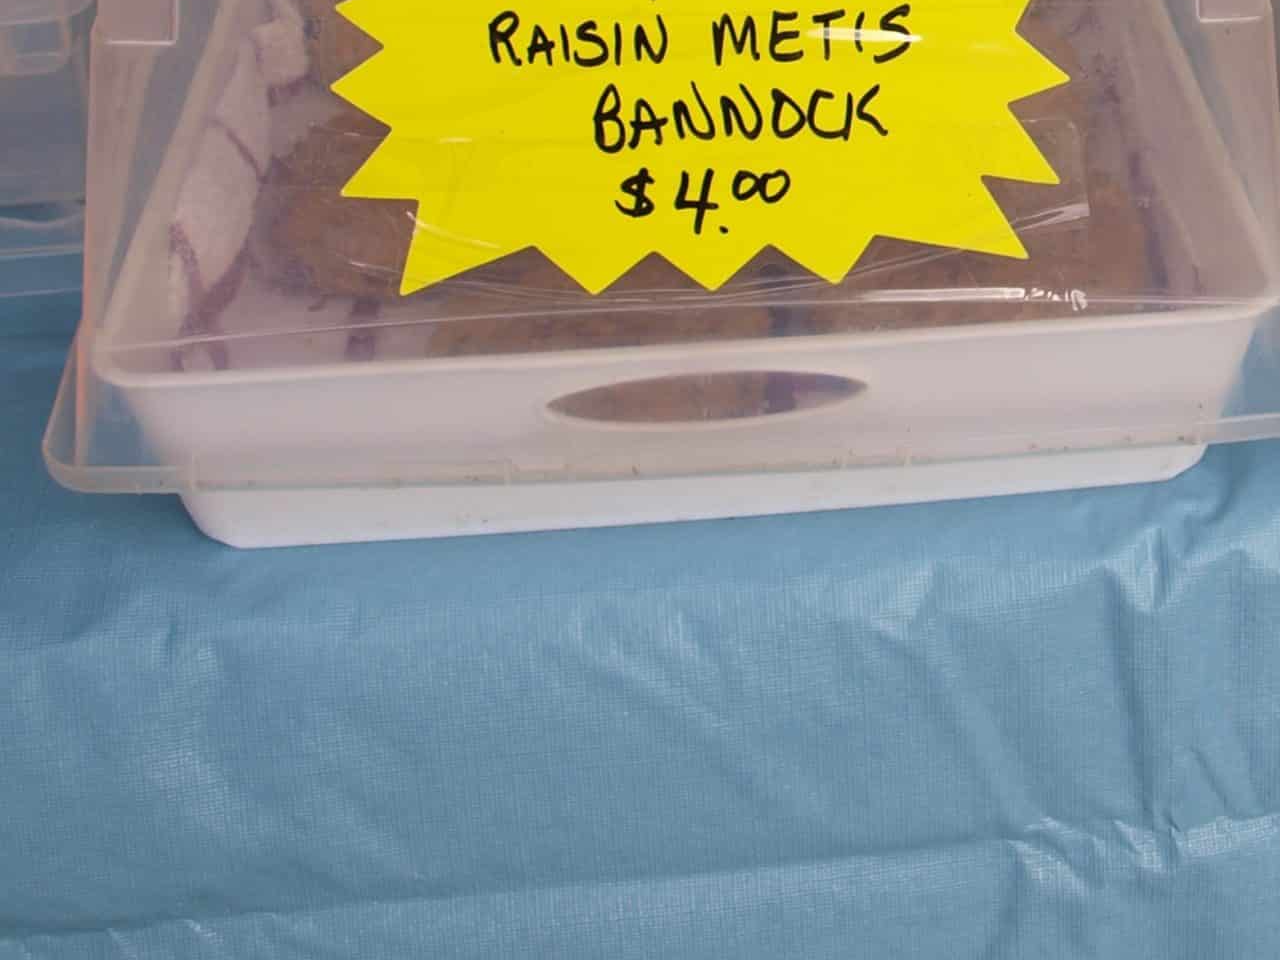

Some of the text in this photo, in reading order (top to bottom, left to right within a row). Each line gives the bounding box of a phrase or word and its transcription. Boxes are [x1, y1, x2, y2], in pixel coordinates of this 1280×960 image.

[488, 3, 911, 67] RAISIN METIS
[592, 81, 889, 153] BANNOCK
